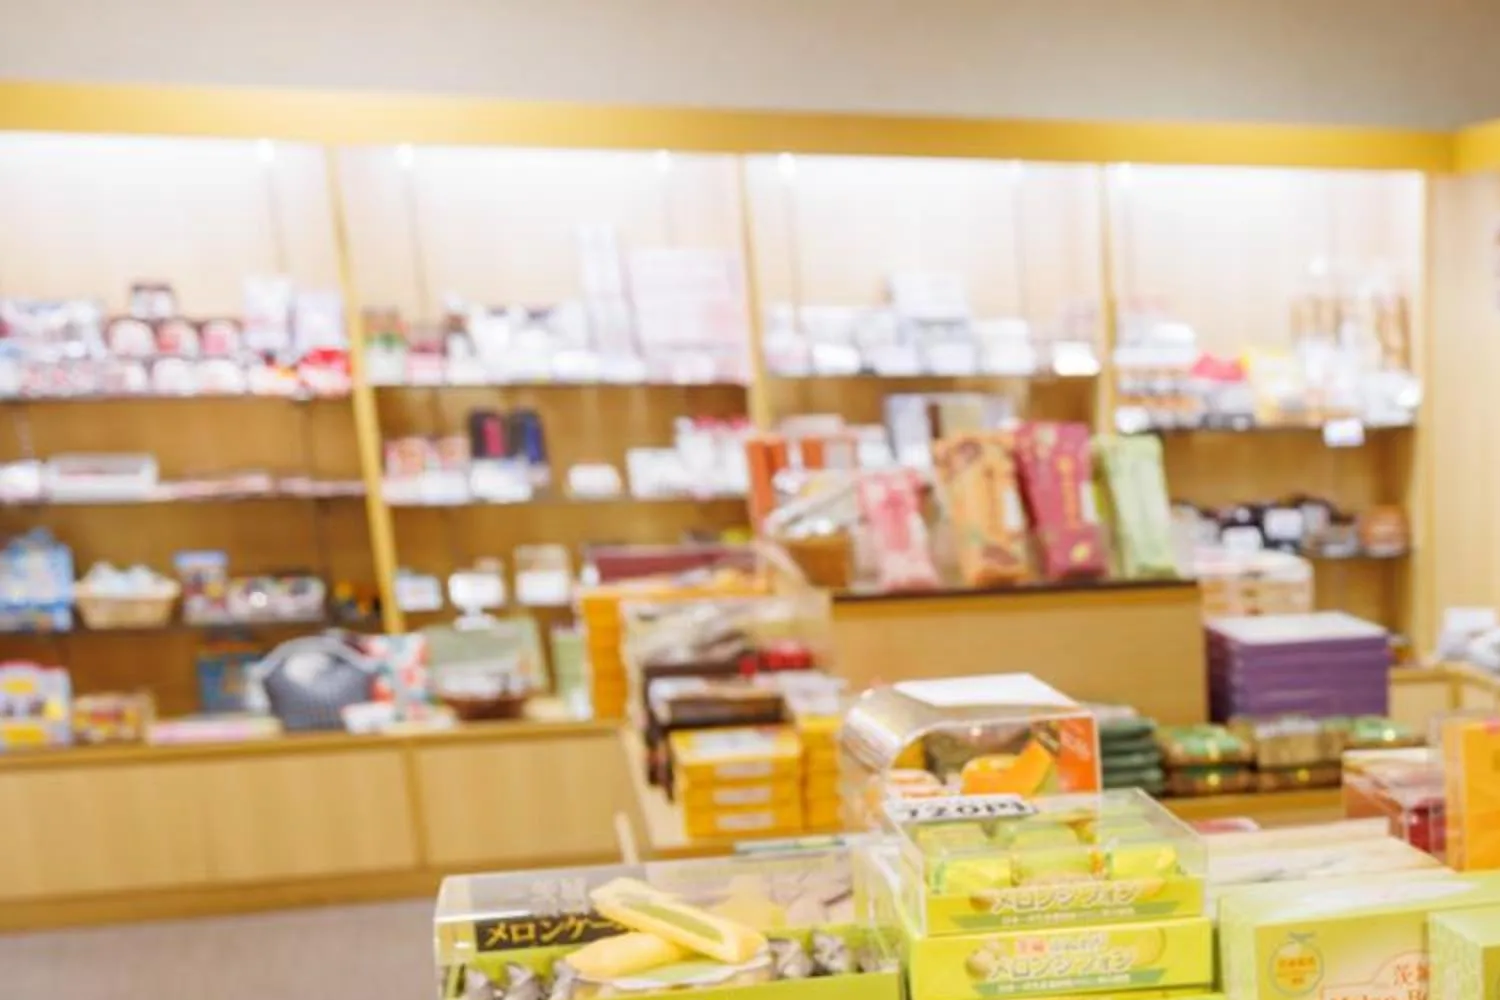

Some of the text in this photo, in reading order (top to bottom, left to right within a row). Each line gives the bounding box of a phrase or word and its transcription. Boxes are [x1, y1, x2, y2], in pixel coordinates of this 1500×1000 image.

[486, 913, 628, 946] メロンケー
